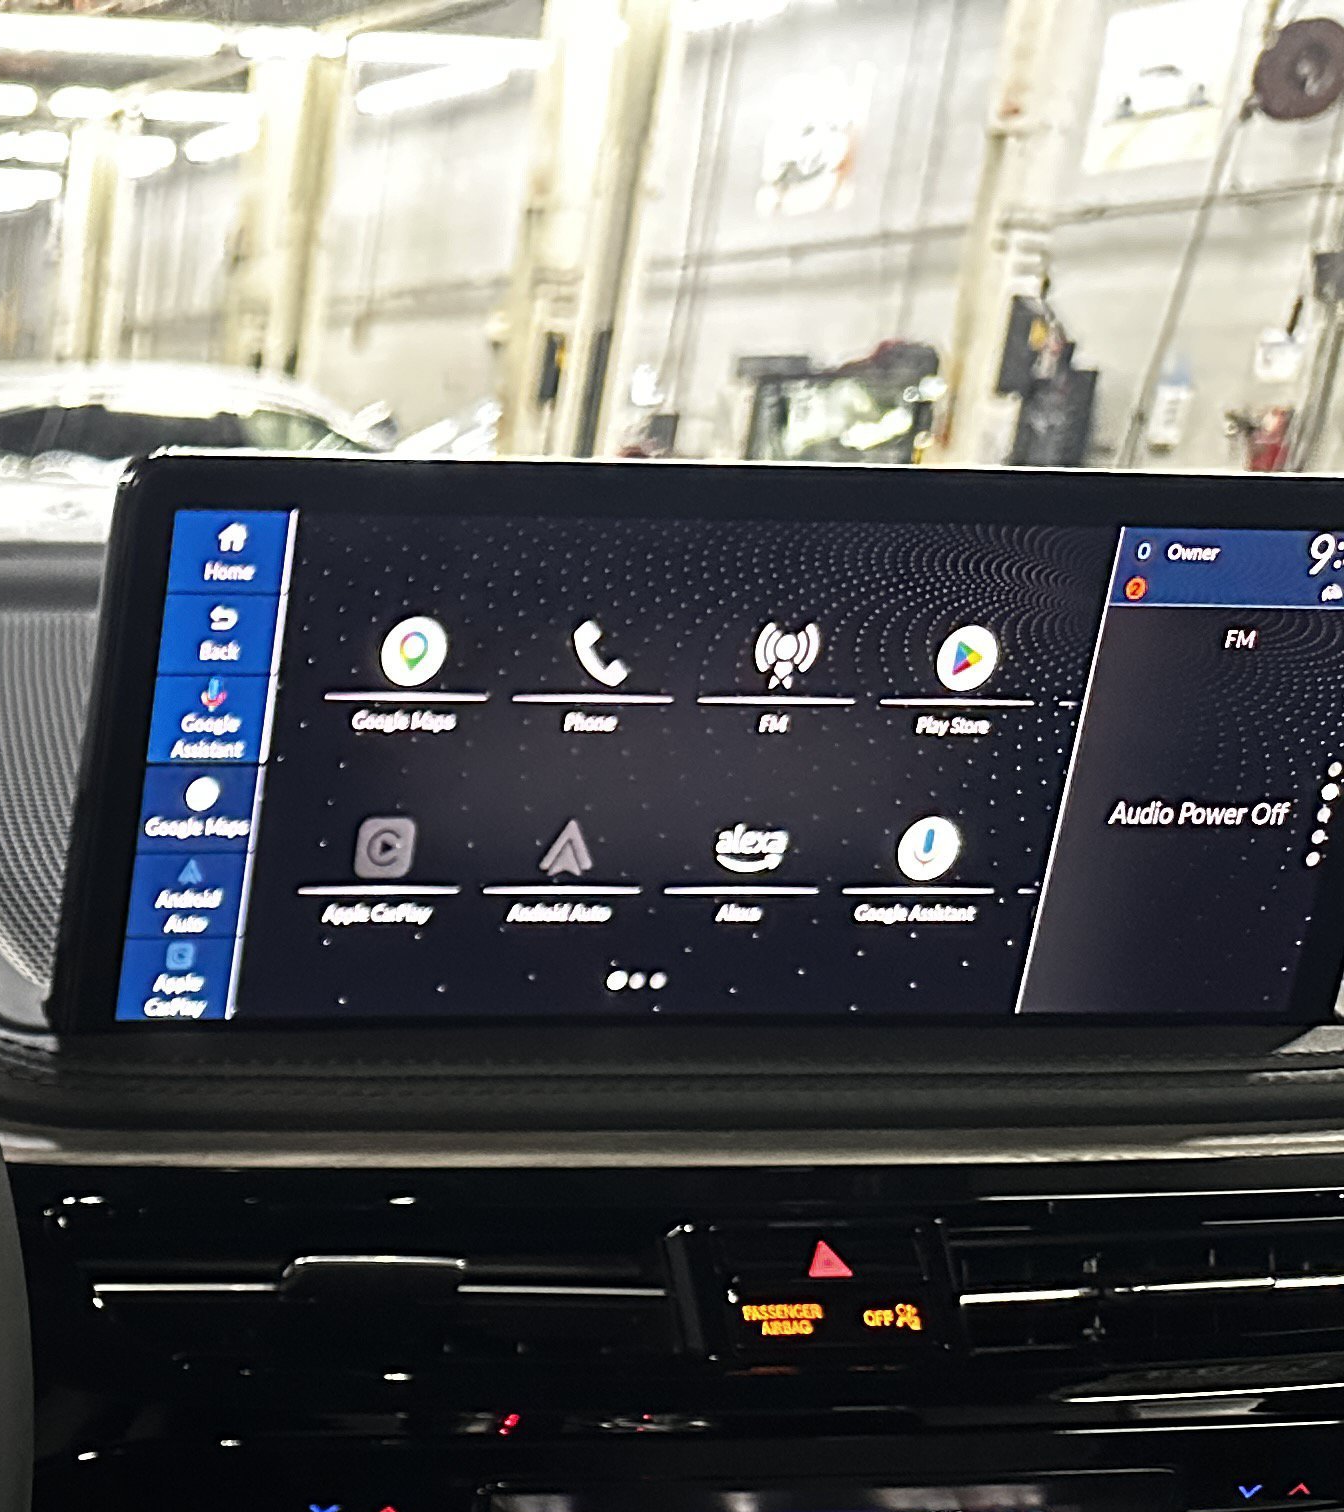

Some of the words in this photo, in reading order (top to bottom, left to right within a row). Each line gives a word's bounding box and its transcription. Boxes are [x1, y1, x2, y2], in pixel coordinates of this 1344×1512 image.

[1167, 543, 1222, 561] Owner
[204, 564, 255, 581] Home
[1224, 629, 1258, 649] FM
[199, 643, 241, 660] Back
[180, 715, 241, 734] Google
[352, 712, 409, 733] Google
[411, 712, 456, 733] Maps
[563, 712, 617, 731] Phone
[758, 714, 788, 733] FM
[916, 716, 947, 737] Play
[949, 717, 989, 734] Store
[170, 741, 244, 759] Assistant
[1109, 802, 1174, 825] Audio
[1178, 802, 1248, 825] Power
[1251, 802, 1291, 825] Off
[145, 818, 201, 838] Google
[204, 818, 250, 838] Maps
[715, 823, 788, 855] alexa
[154, 890, 223, 908] Android
[322, 904, 369, 926] Apple
[370, 904, 433, 926] CarPlay
[506, 904, 569, 923] Android
[569, 904, 611, 923] Auto
[854, 904, 907, 926] Google
[908, 904, 975, 923] Assistant
[163, 916, 208, 933] Auto
[153, 975, 204, 995] Apple
[144, 999, 207, 1019] CarPlay
[742, 1303, 824, 1321] PASSENGER
[863, 1309, 894, 1327] OFF
[761, 1319, 814, 1336] AIRBAG
